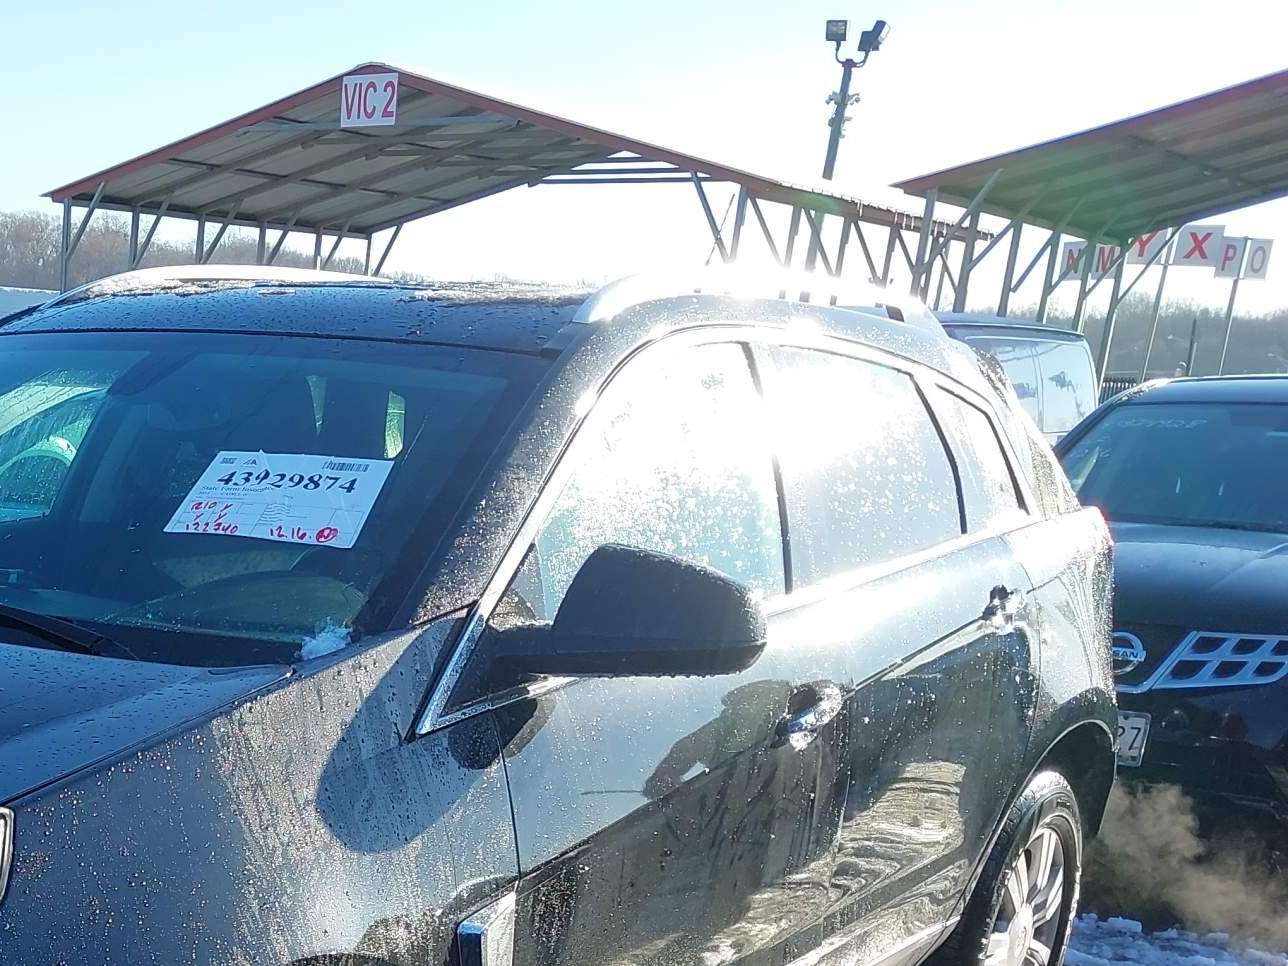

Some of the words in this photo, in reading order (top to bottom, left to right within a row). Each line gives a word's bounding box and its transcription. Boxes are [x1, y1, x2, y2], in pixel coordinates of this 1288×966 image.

[344, 81, 377, 120] VIC
[382, 81, 395, 117] 2
[1136, 231, 1159, 257] Y
[1184, 232, 1214, 259] X
[1221, 244, 1237, 271] P
[217, 469, 357, 493] 43929874
